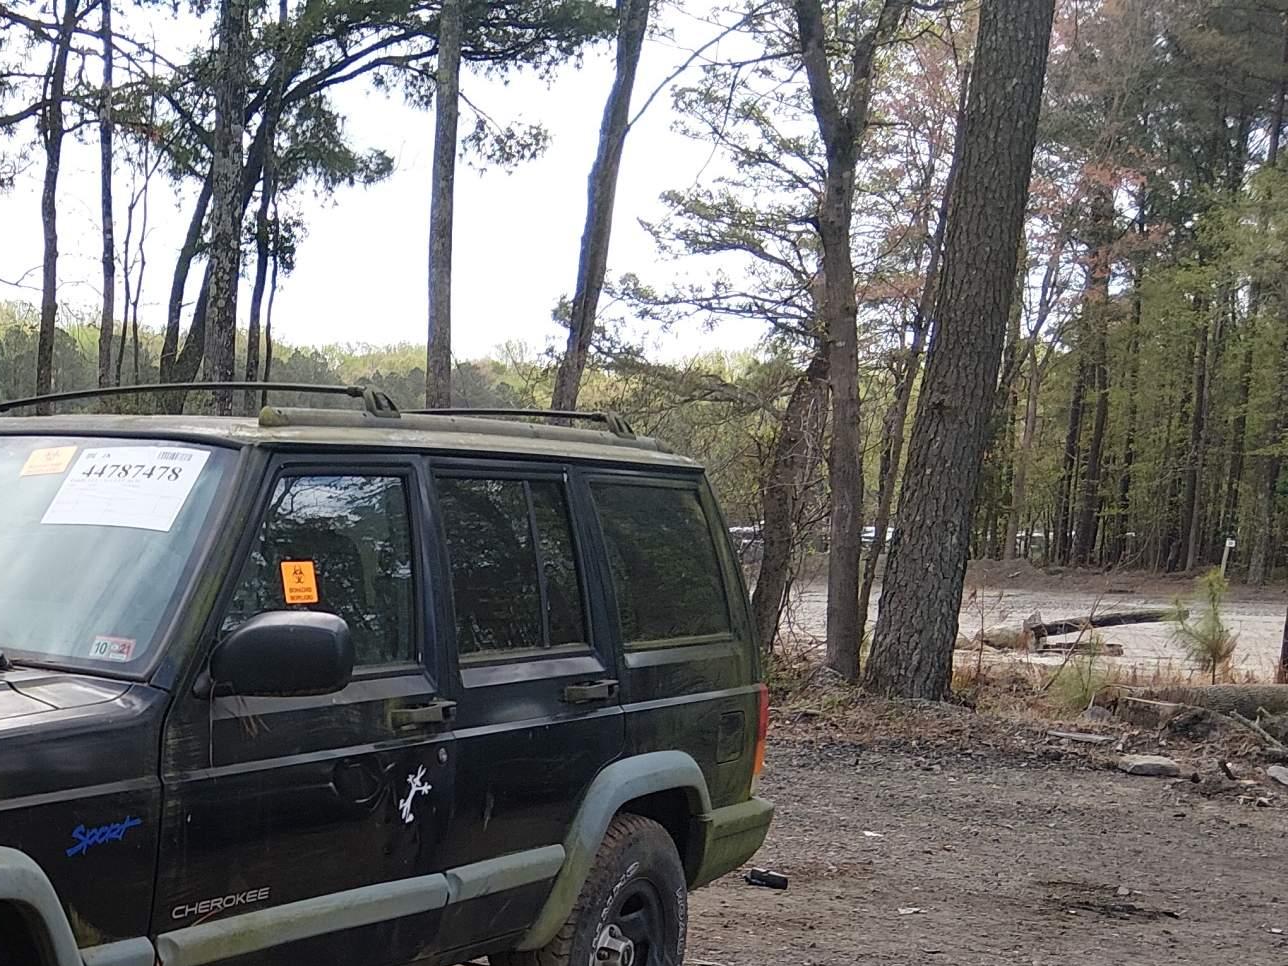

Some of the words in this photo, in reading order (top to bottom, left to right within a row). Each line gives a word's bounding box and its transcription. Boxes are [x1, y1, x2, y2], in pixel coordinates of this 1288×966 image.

[82, 463, 183, 482] 44787478
[94, 641, 108, 655] 10
[65, 815, 143, 857] Sport
[171, 886, 271, 920] CHEROKEE
